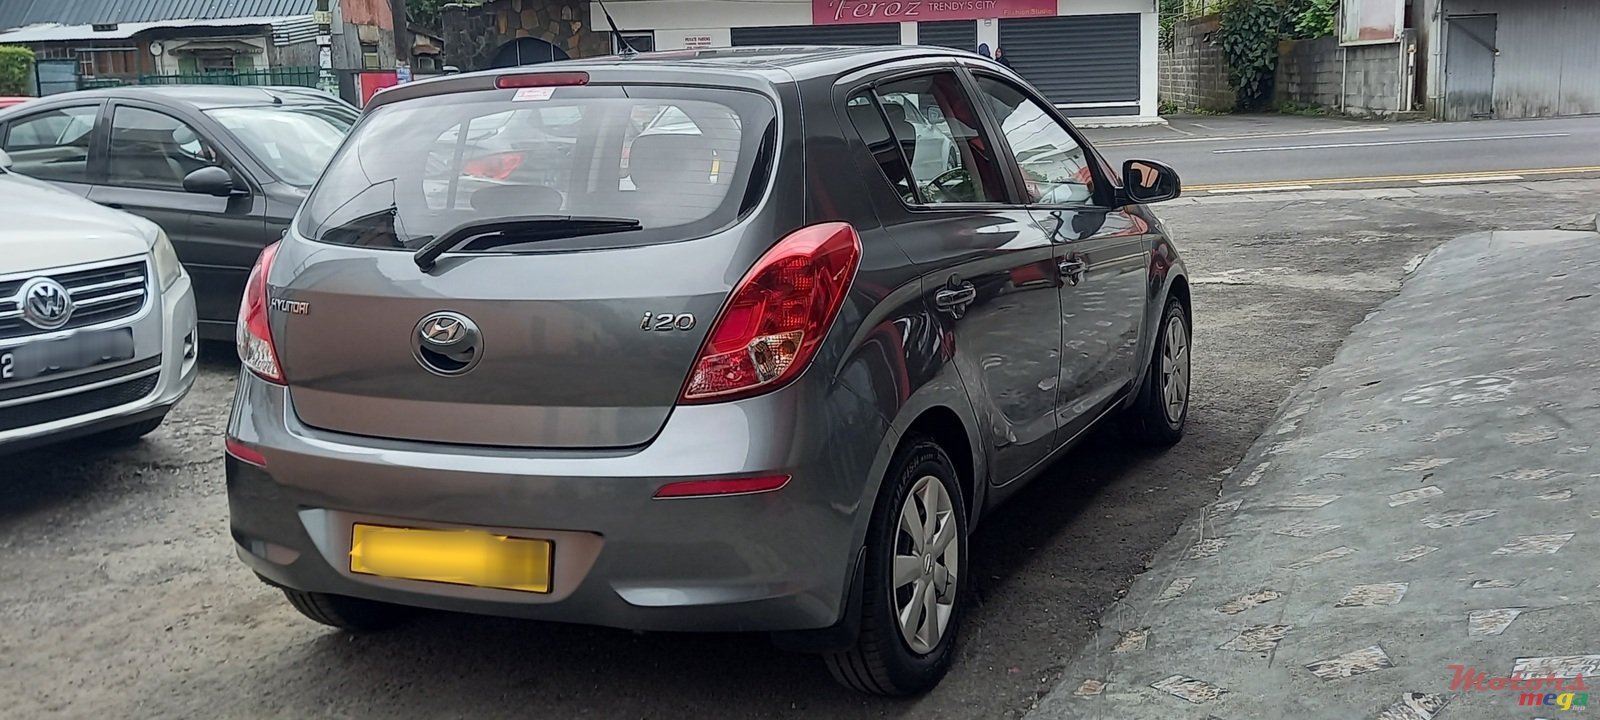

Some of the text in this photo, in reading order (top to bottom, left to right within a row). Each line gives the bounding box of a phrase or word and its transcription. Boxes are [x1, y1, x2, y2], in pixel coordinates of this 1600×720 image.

[929, 2, 974, 11] TRENDY'S
[975, 0, 997, 10] CITY
[271, 298, 310, 315] HYUNDAI
[640, 311, 697, 332] i20
